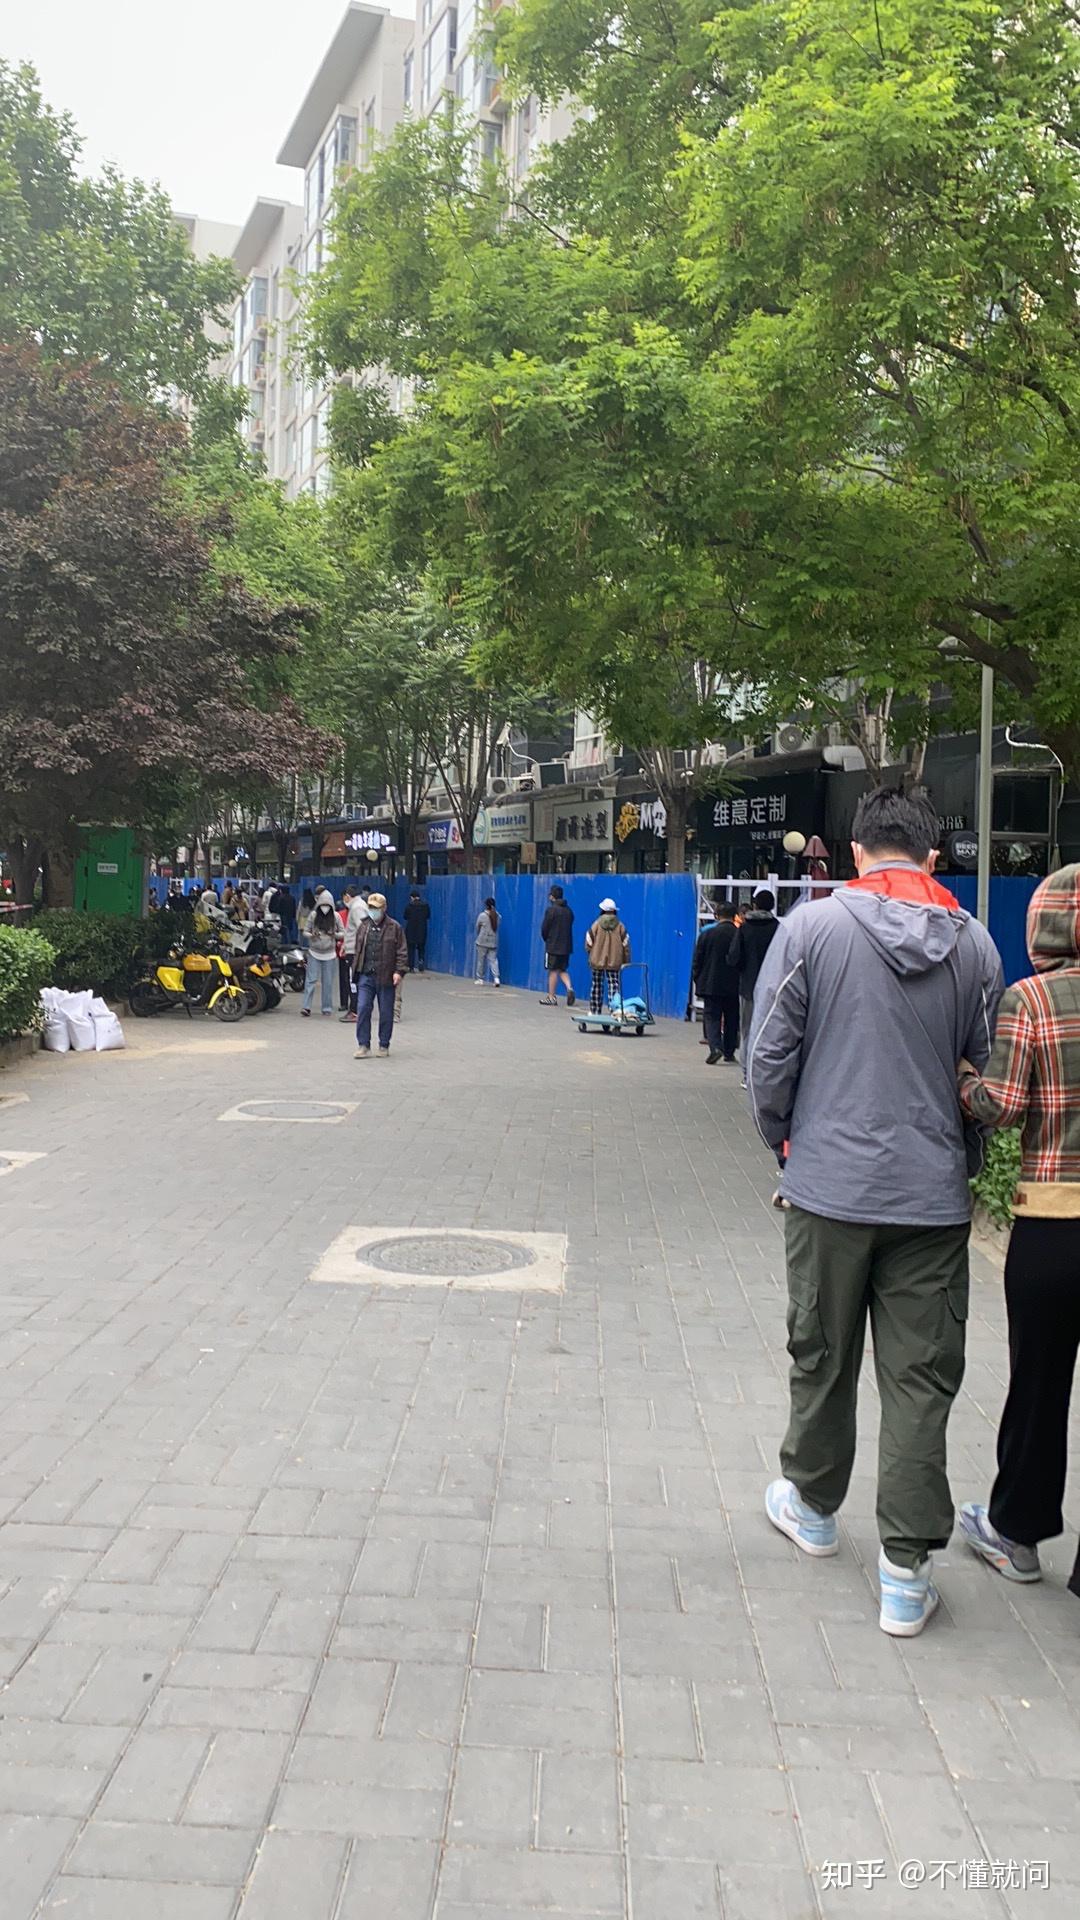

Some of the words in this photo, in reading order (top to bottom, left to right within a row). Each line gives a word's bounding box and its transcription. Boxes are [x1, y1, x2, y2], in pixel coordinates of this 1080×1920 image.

[713, 794, 787, 827] 维意定制
[955, 842, 978, 850] BEER
